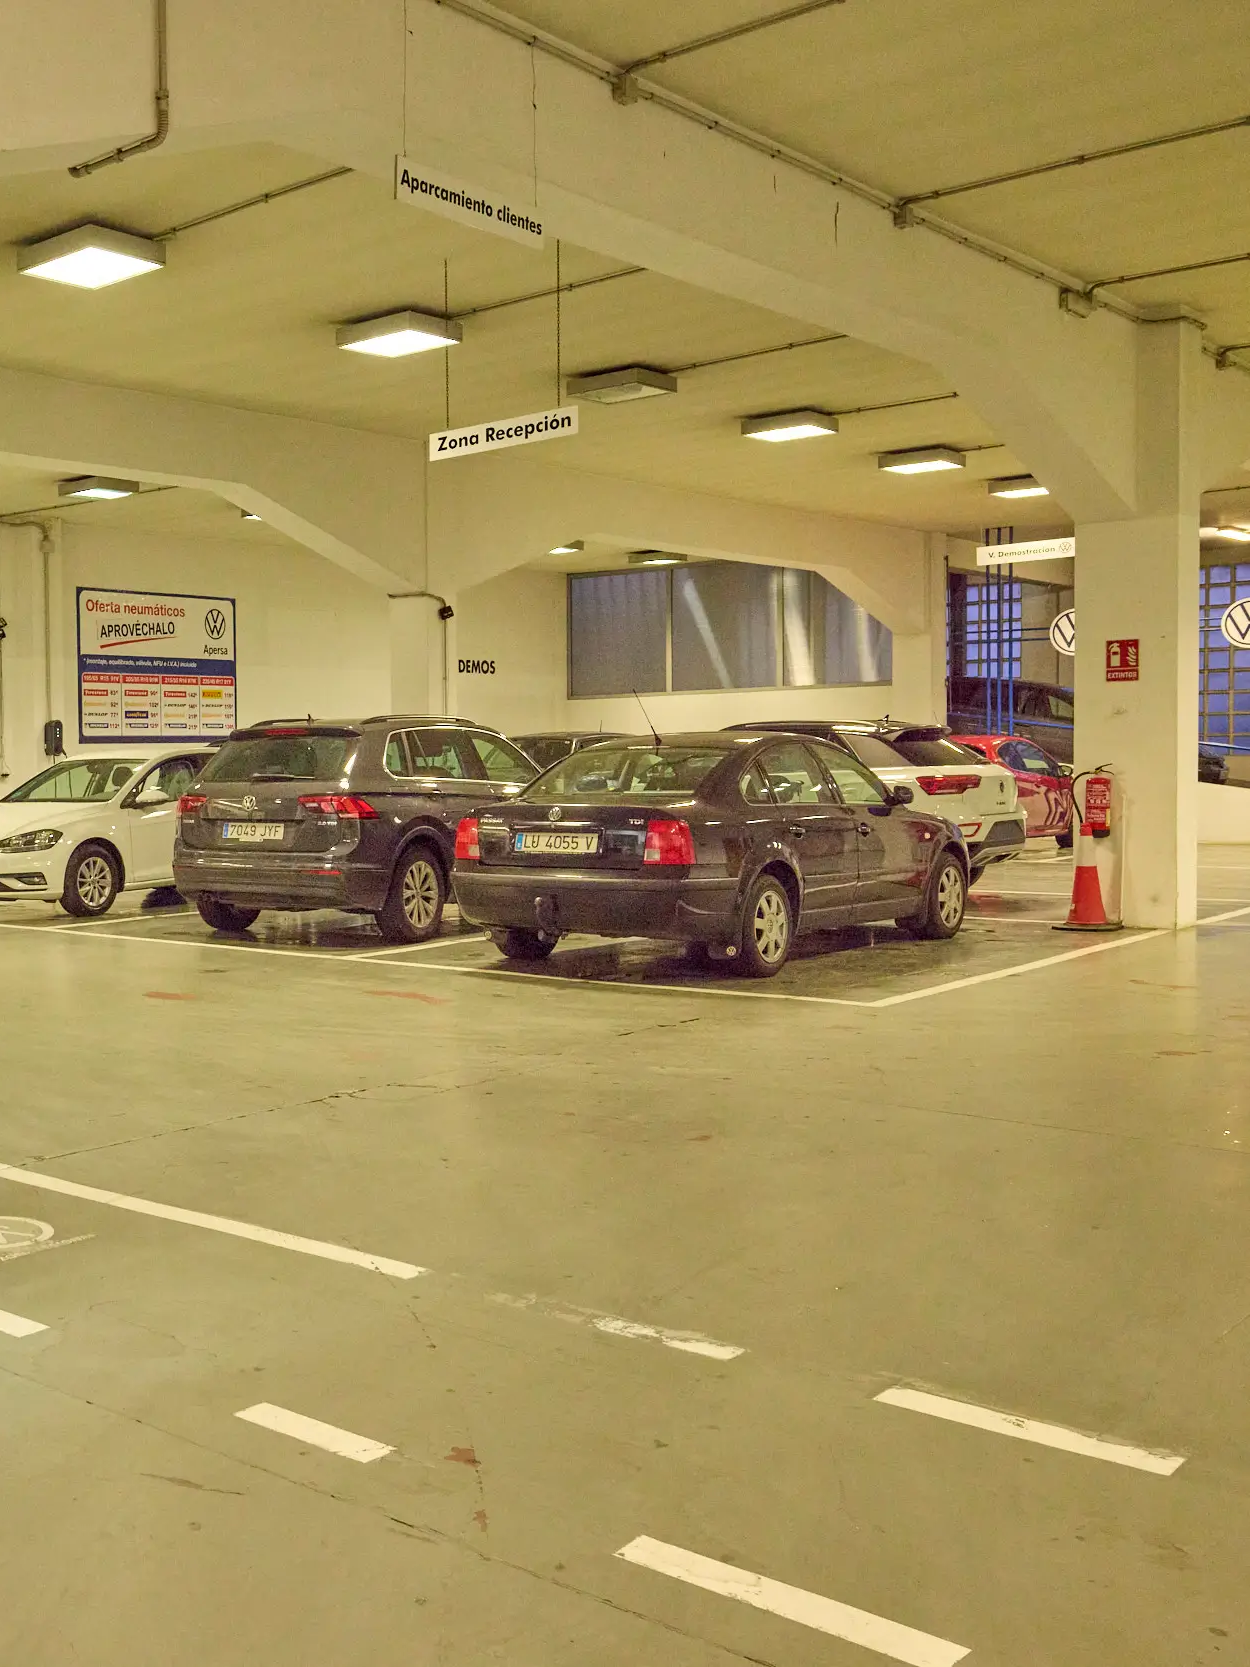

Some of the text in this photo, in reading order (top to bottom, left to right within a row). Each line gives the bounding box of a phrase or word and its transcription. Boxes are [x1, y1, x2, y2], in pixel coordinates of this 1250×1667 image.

[400, 168, 542, 235] Aparcamiento clientes
[437, 413, 572, 452] Zona Recepción
[85, 599, 185, 618] Oferta neumáticos
[100, 620, 175, 638] APROVÉCHALO
[203, 645, 228, 656] Apersa
[458, 659, 496, 675] DEMOS
[230, 824, 282, 837] 7049 JYF
[523, 835, 593, 850] LU 4055 V
